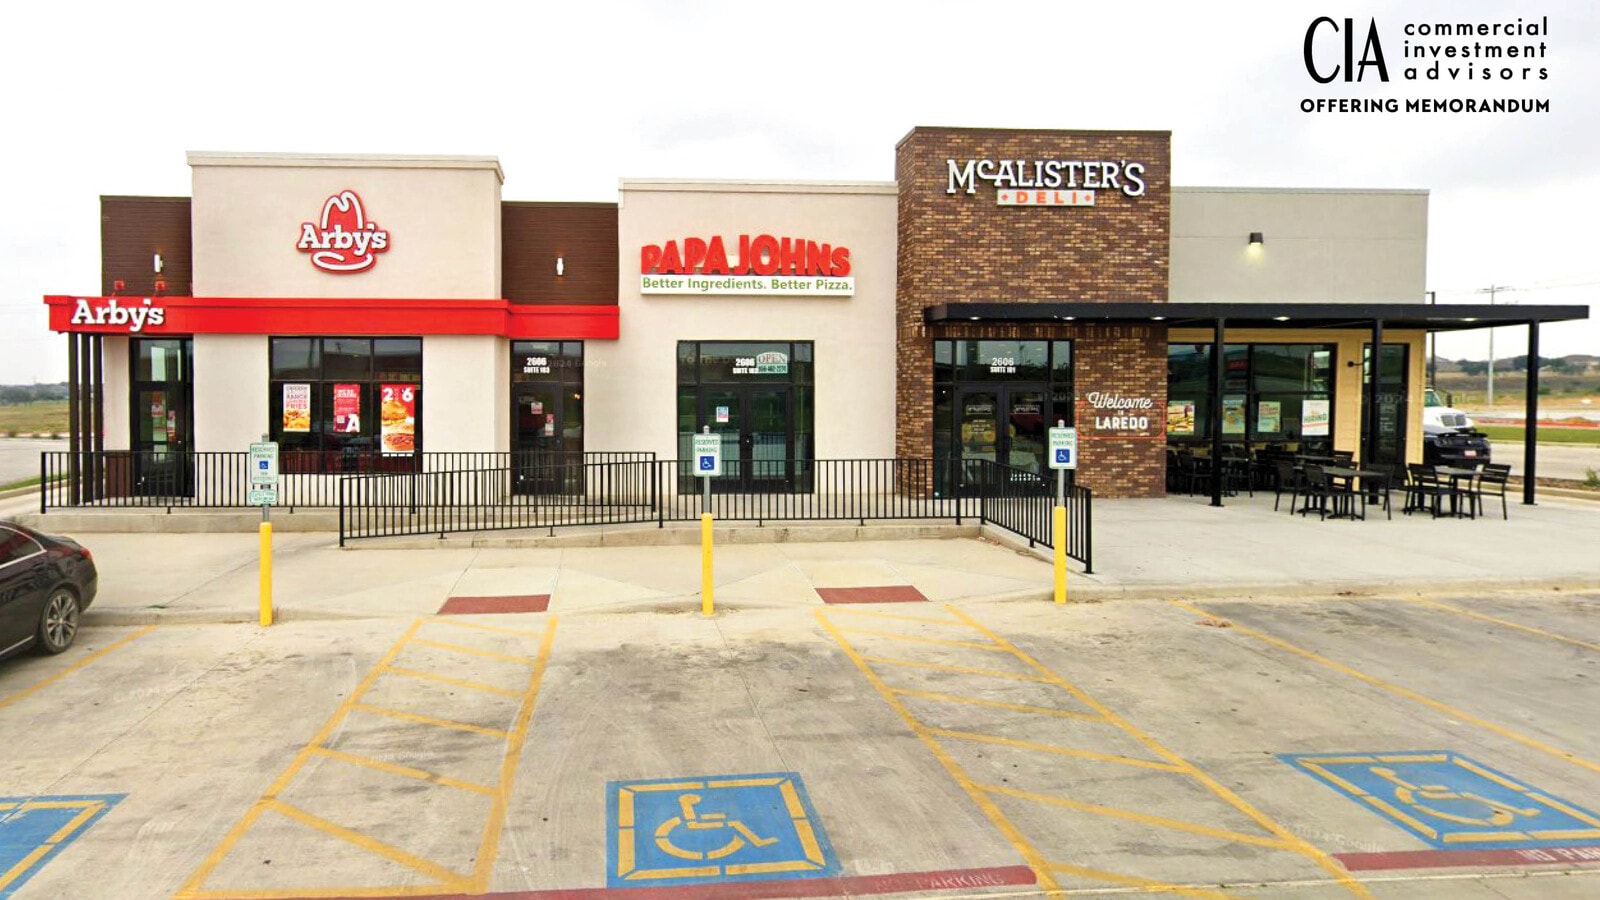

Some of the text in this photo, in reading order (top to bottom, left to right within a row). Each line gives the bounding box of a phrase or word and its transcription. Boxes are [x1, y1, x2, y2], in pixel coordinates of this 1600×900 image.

[1015, 191, 1077, 204] DELI
[298, 222, 388, 257] Arby's
[641, 234, 852, 277] PAPA JOHNS
[642, 277, 853, 292] Better Ingredients. Better Pizza.
[71, 298, 165, 332] Arby's
[758, 353, 786, 364] OPEN
[991, 357, 1014, 366] 2606
[1086, 391, 1153, 409] Welcome
[1095, 416, 1148, 430] LAREDO
